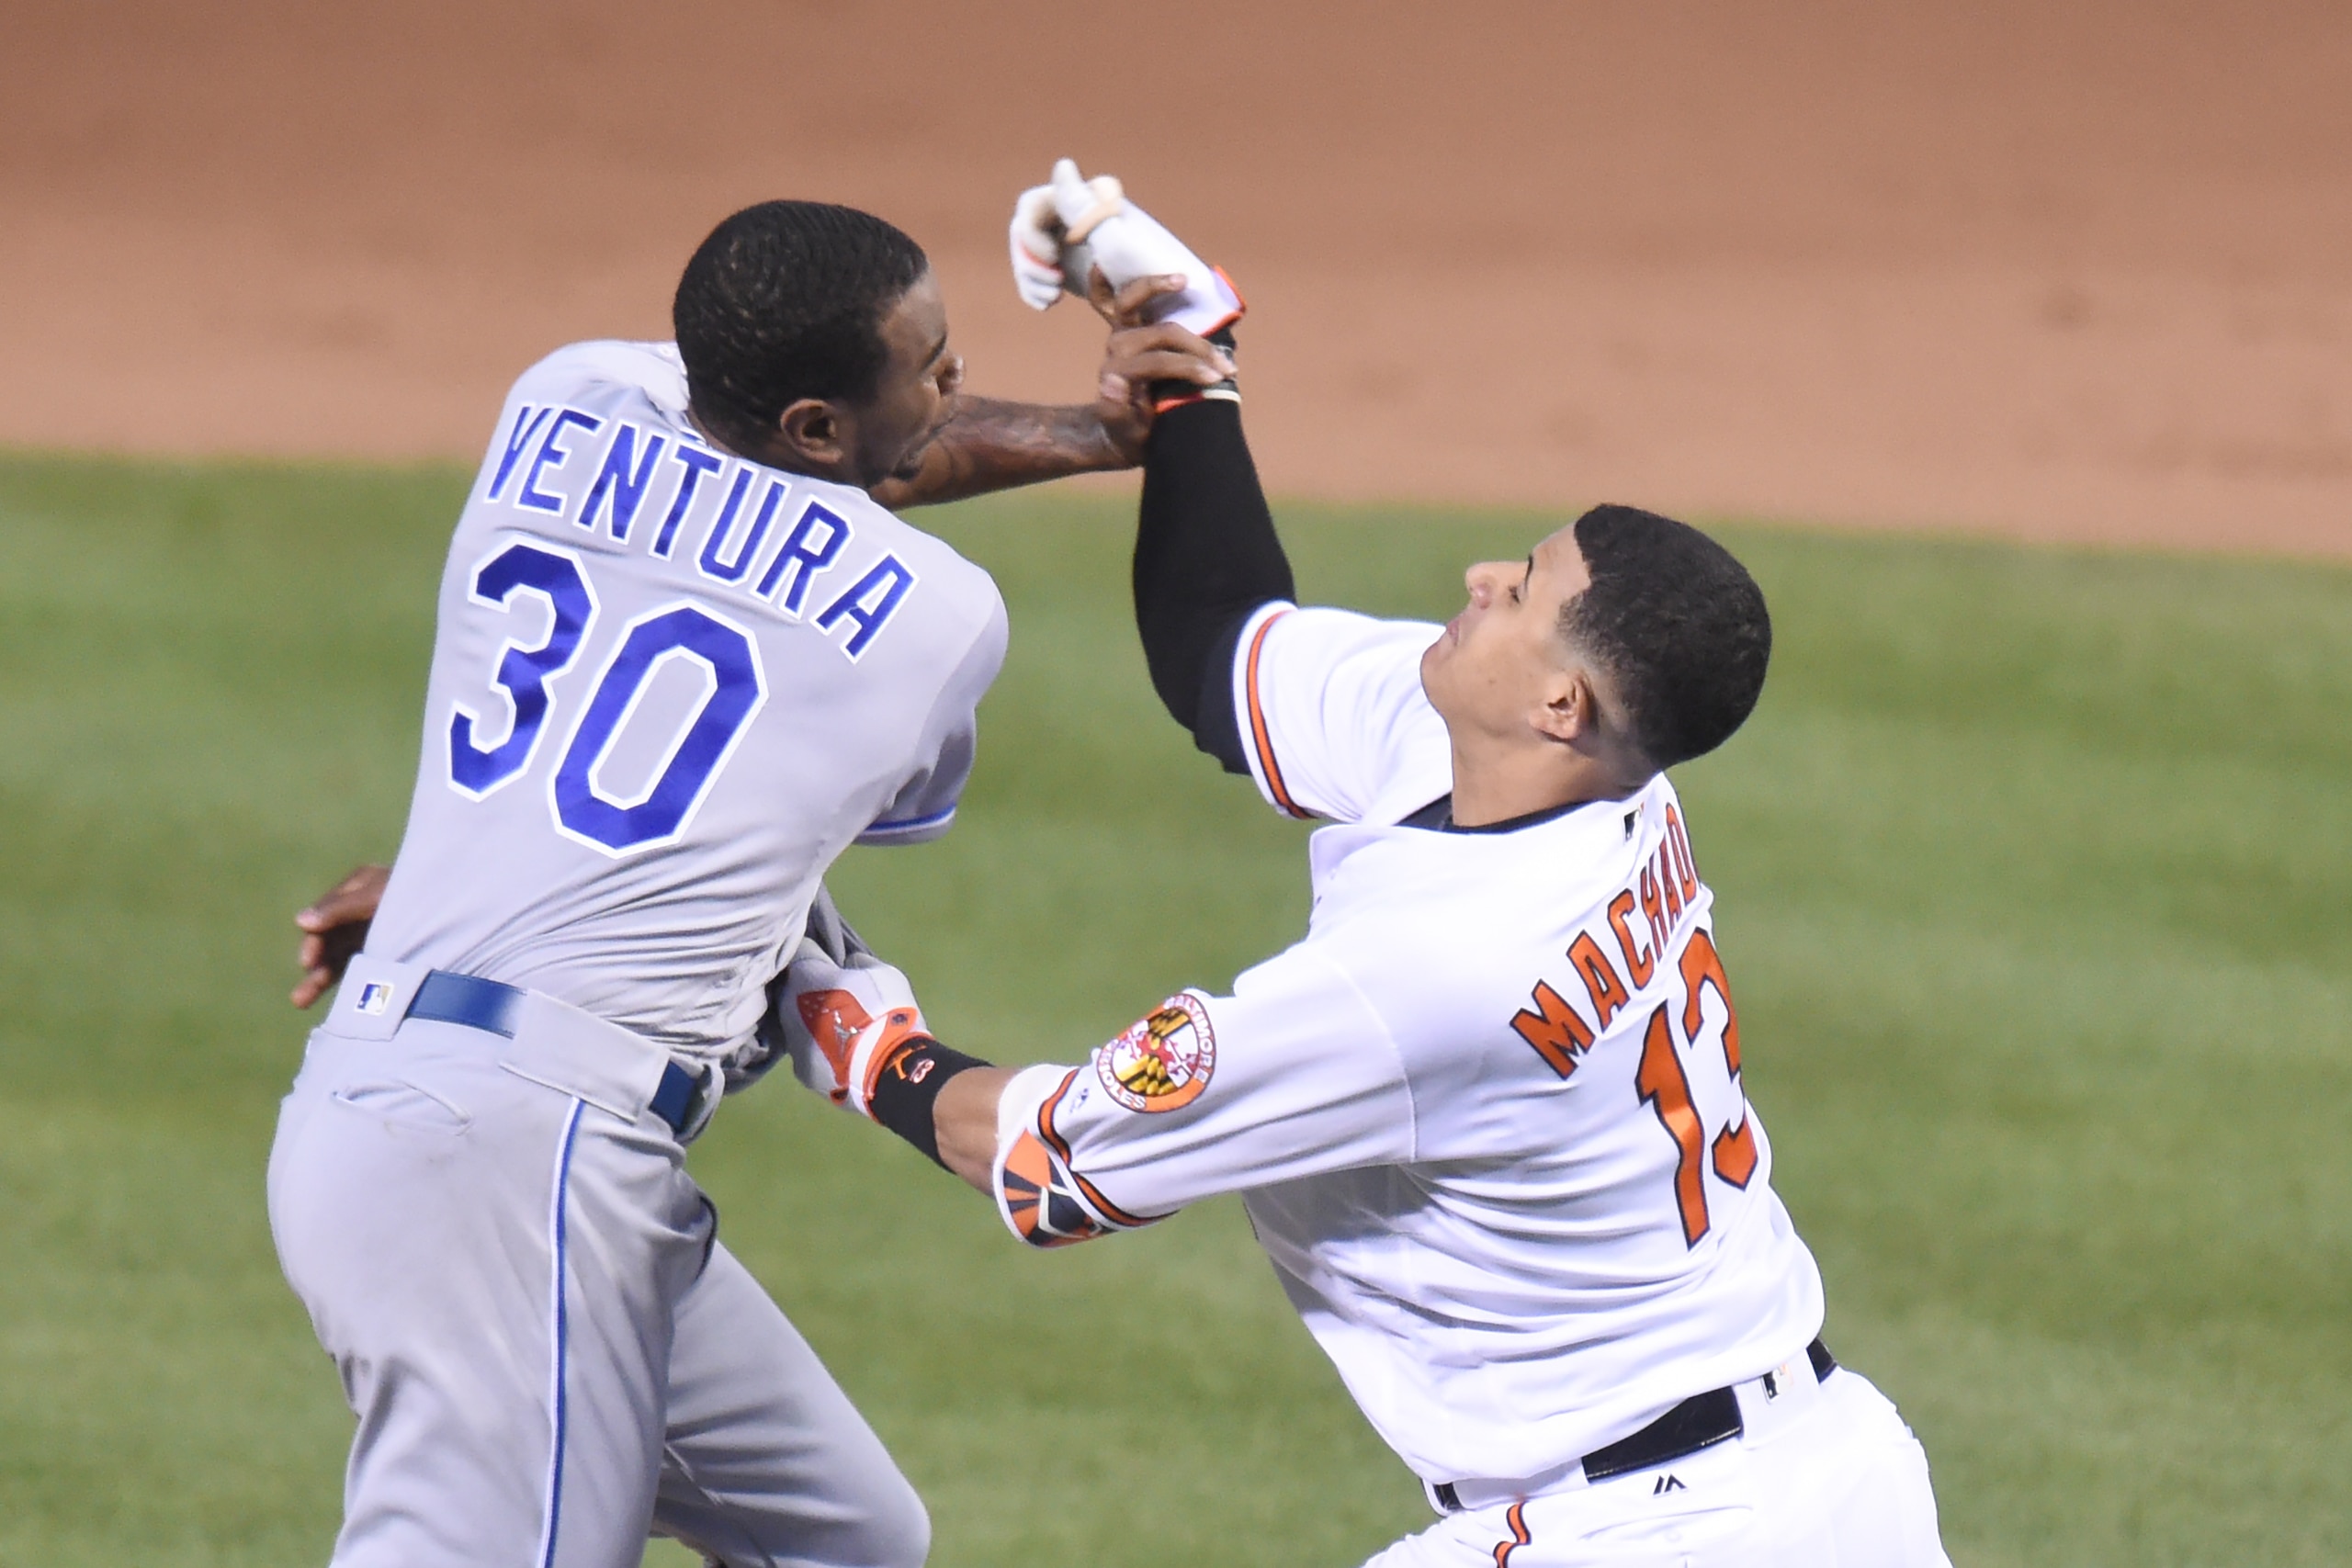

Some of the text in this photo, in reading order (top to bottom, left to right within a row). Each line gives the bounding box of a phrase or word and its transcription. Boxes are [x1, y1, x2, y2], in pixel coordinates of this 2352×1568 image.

[485, 401, 920, 664] VENTURA
[447, 535, 770, 859] 30
[1510, 802, 1702, 1081] MACHAD
[1634, 926, 1758, 1252] 13
